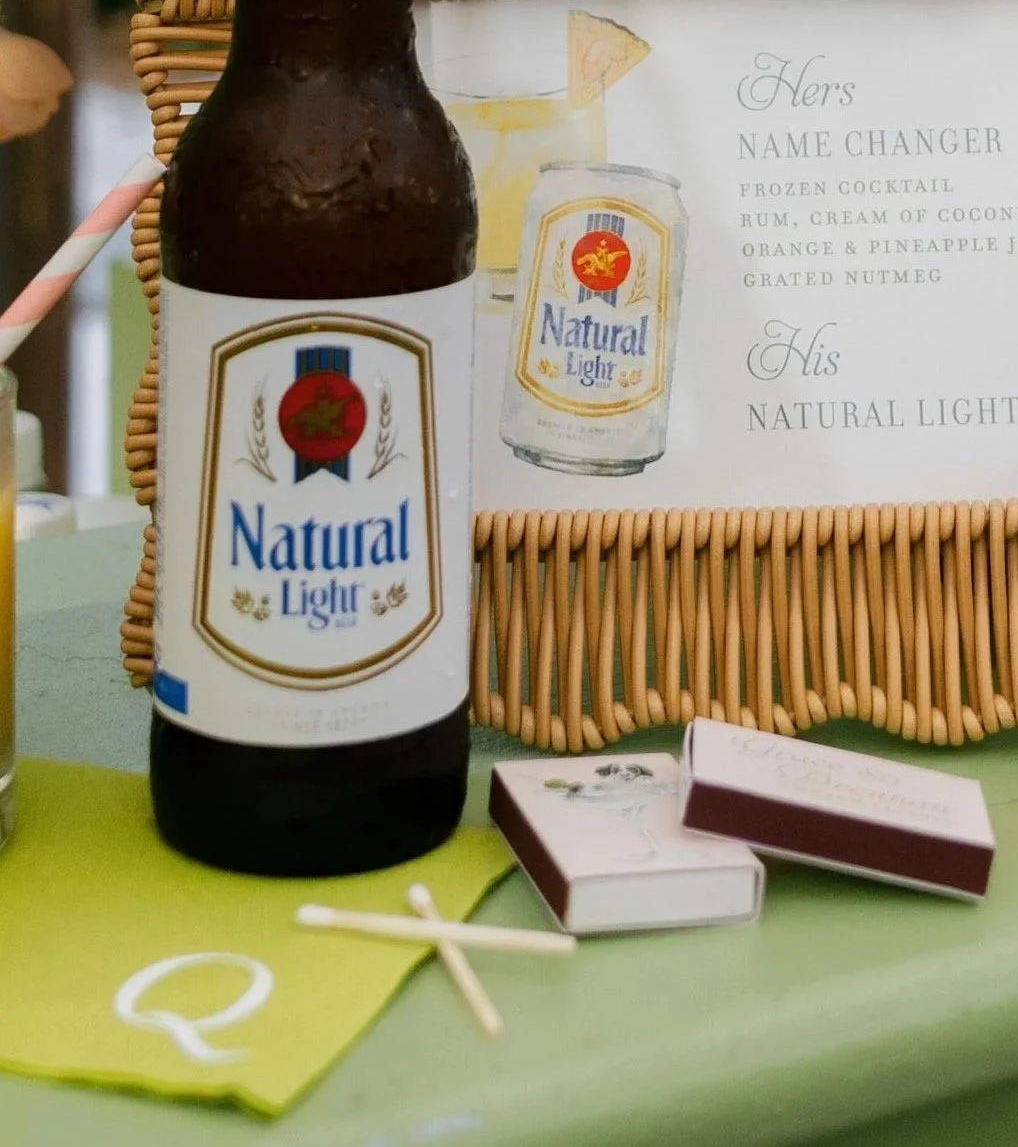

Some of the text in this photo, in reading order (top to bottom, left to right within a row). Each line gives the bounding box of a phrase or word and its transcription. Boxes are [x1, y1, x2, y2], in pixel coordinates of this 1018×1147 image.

[737, 53, 855, 111] Hers
[738, 128, 1002, 159] NAME CHANGER
[740, 179, 953, 197] FROZEN COCKTAIL
[740, 212, 798, 229] RUM,
[810, 210, 887, 225] CREAM
[900, 209, 926, 223] OF
[742, 242, 833, 257] ORANGE
[845, 241, 856, 254] &
[869, 237, 998, 254] PINEAPPLE
[744, 269, 941, 287] GRATED NUTMEG
[540, 302, 649, 356] Natural
[747, 320, 840, 380] His
[566, 352, 616, 387] Light
[748, 397, 1018, 431] NATURAL LIGHT
[231, 499, 410, 572] Natural
[281, 578, 362, 630] Light
[113, 952, 273, 1064] Q
